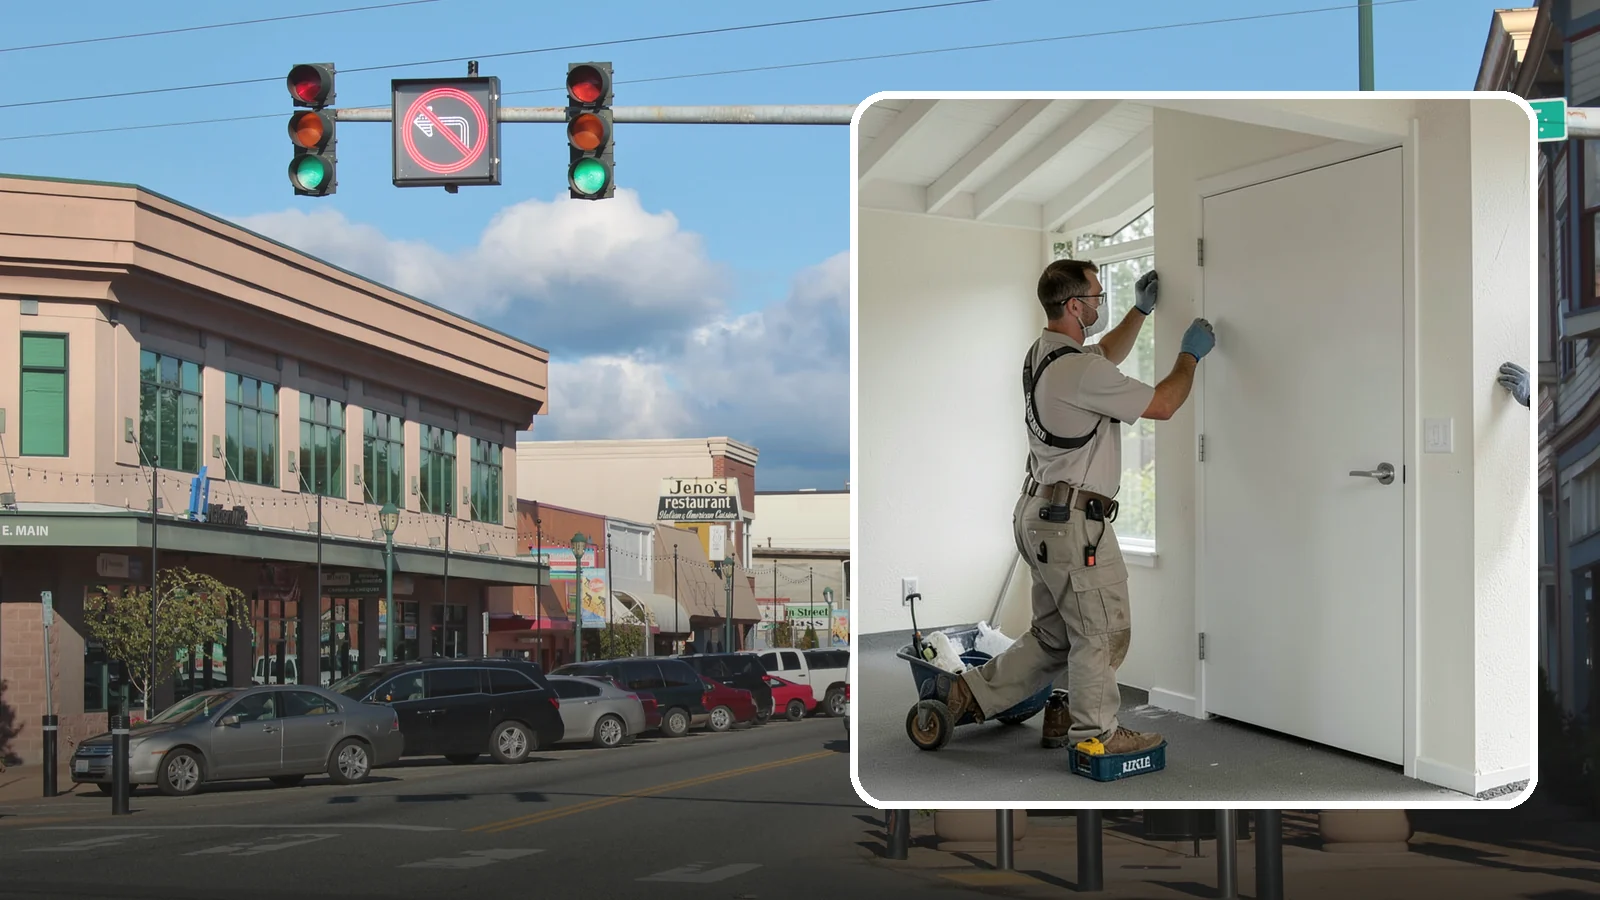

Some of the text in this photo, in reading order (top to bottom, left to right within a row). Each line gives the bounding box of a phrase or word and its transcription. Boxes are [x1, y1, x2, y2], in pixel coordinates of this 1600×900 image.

[669, 480, 727, 495] Jeno's
[665, 496, 731, 509] restaurant
[659, 510, 681, 519] Italian
[686, 510, 715, 519] American
[715, 509, 737, 519] Cuisine
[2, 525, 49, 536] E. MAIN
[797, 607, 828, 617] Street
[791, 619, 824, 627] lass
